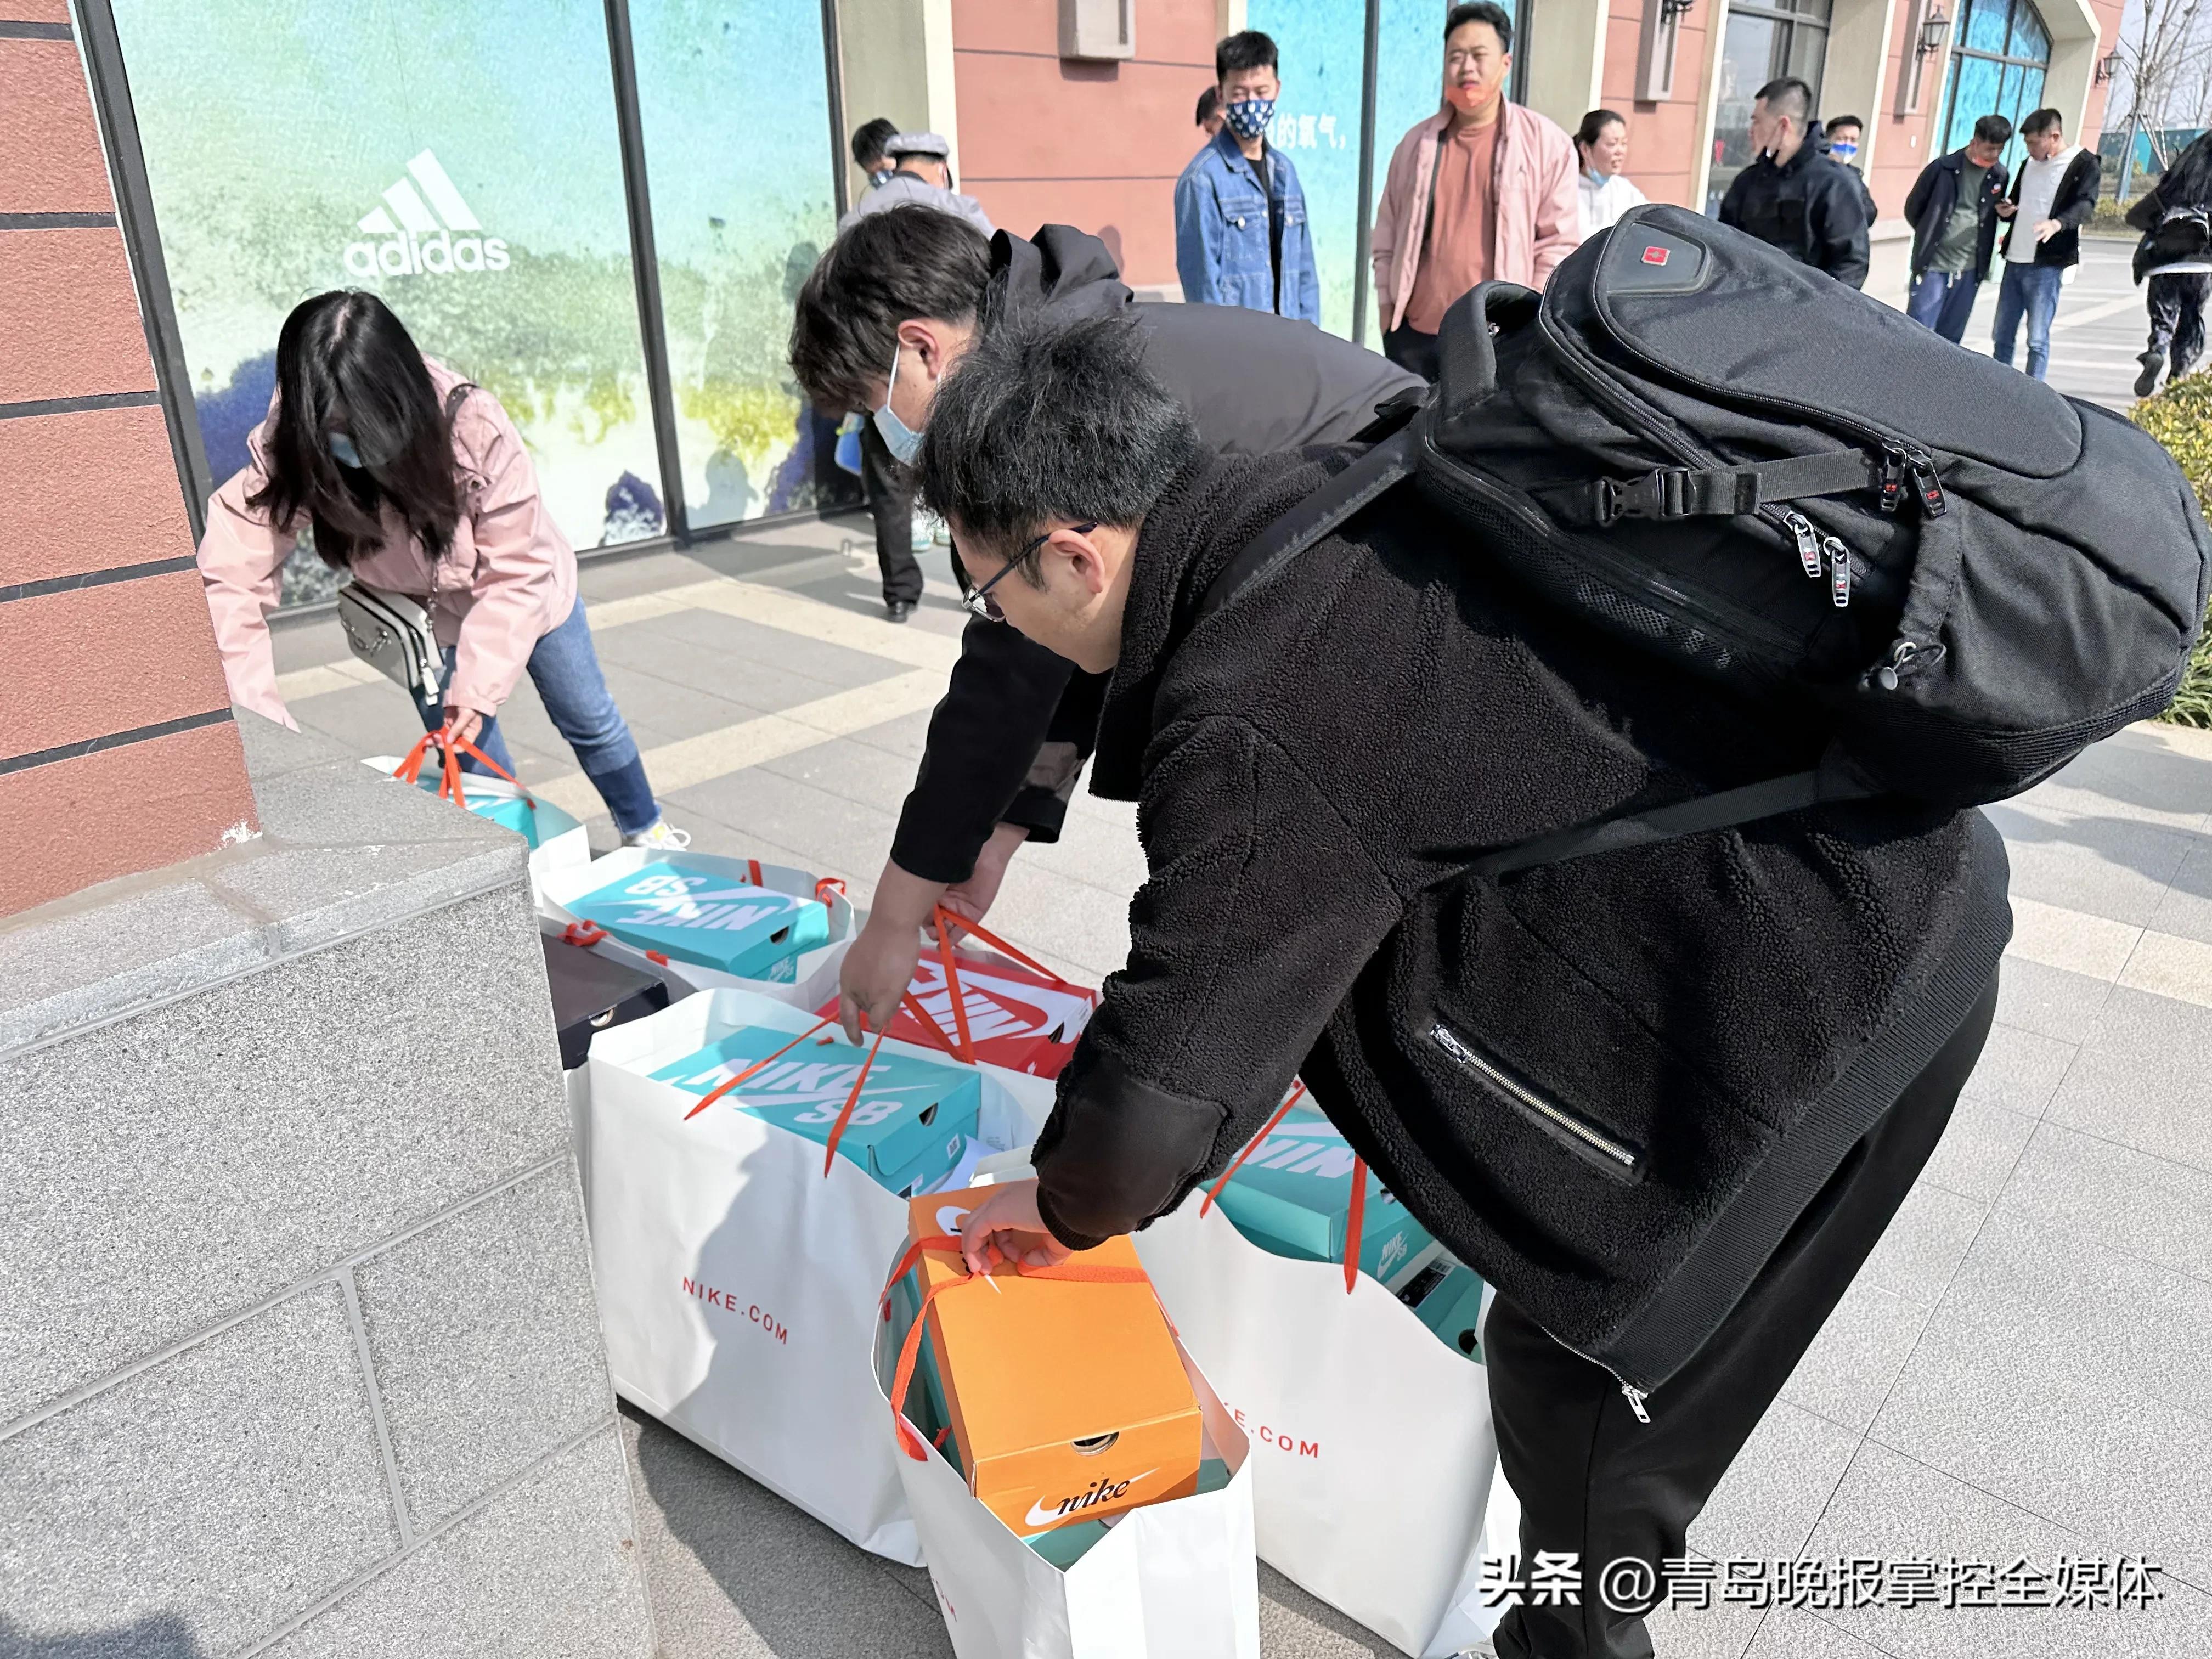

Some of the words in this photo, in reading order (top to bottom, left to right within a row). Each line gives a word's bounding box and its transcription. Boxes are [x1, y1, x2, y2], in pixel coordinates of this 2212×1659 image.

[343, 228, 511, 277] adidas
[624, 875, 708, 896] SB
[615, 902, 780, 931] NIKE
[681, 1058, 892, 1094] NIKE
[794, 1099, 904, 1125] SB
[1232, 1135, 1357, 1178] NIK
[1381, 1230, 1403, 1262] NIKE
[683, 1276, 787, 1345] NIKE.COM
[1224, 1402, 1318, 1458] E.COM
[1056, 1477, 1130, 1515] nike
